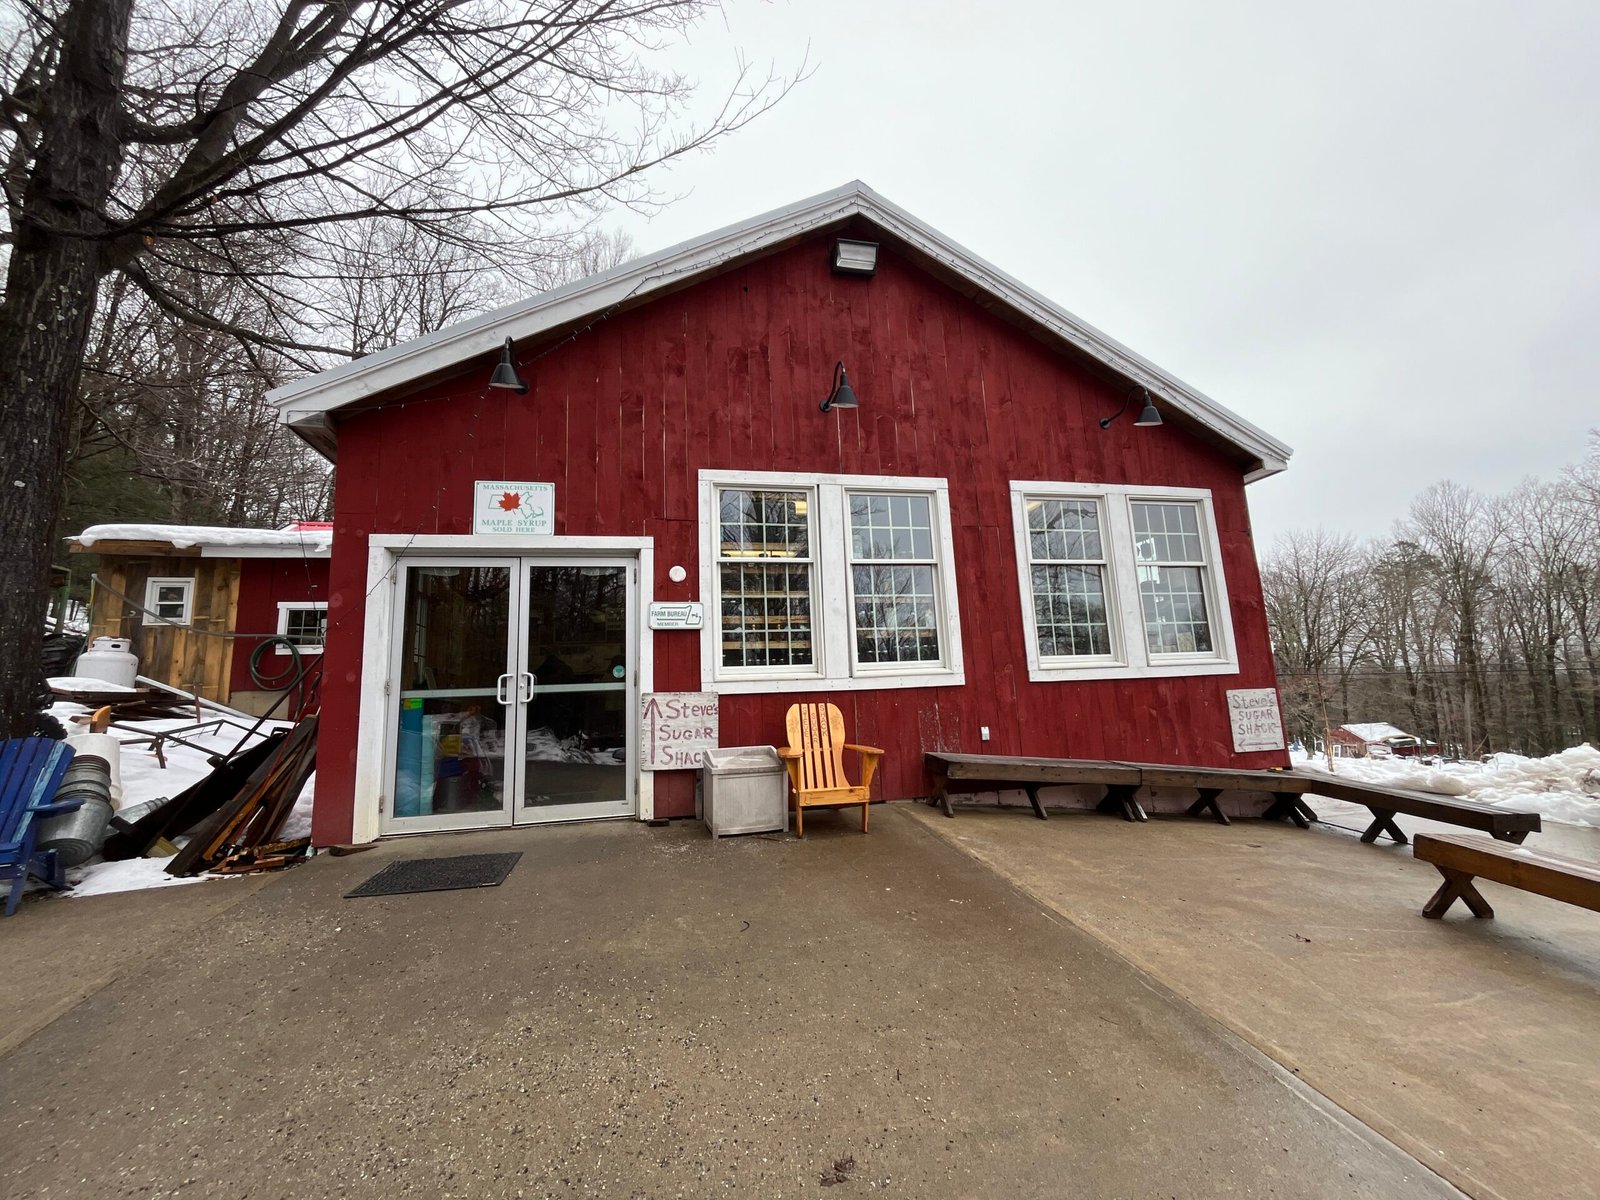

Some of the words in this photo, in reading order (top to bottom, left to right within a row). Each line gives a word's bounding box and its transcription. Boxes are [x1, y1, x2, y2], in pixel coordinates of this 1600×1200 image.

[517, 519, 547, 527] SYRUP
[666, 699, 718, 719] Steve's
[1238, 708, 1274, 721] SUGAR
[659, 724, 714, 741] SUGAR
[1238, 722, 1276, 736] SHACK
[660, 745, 702, 766] SHAC
